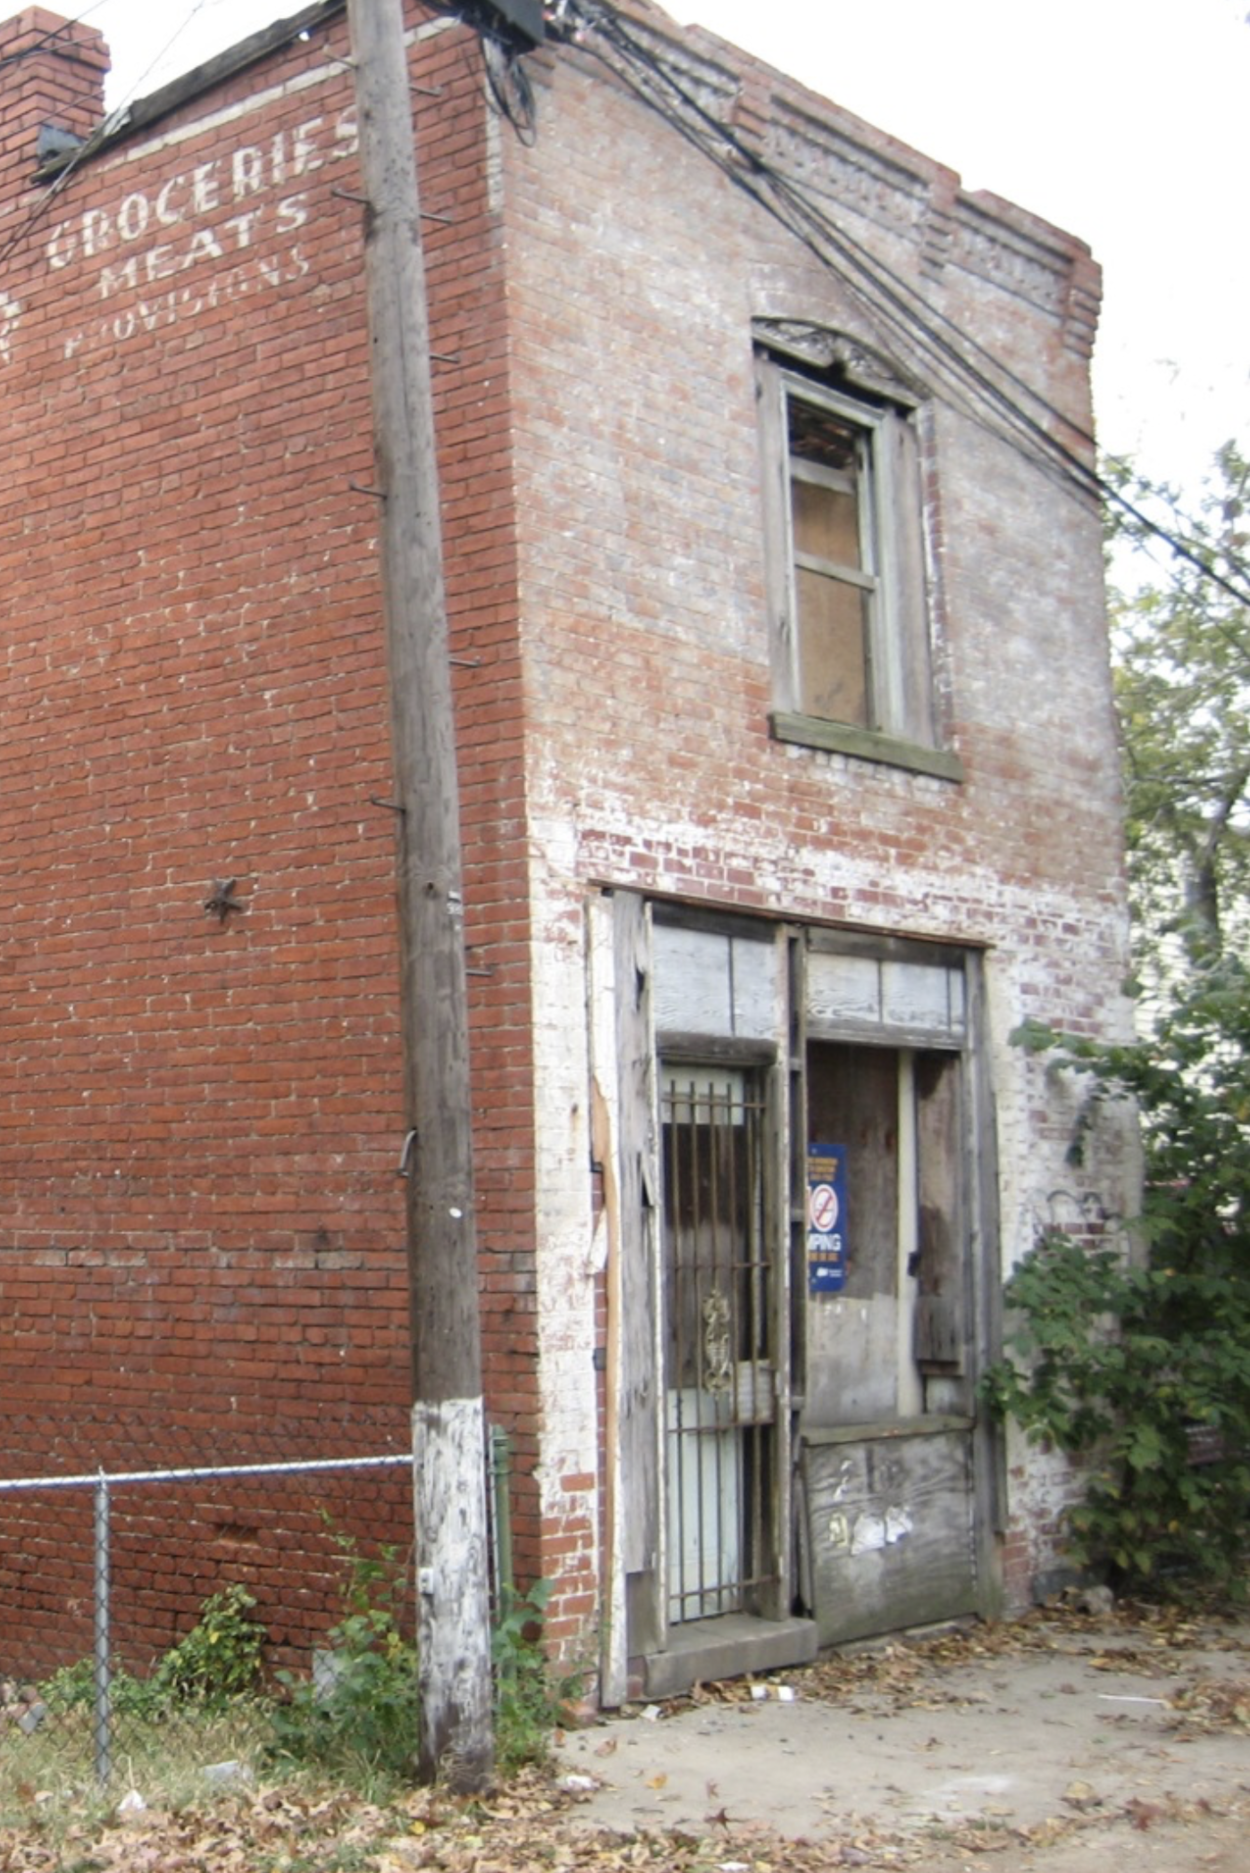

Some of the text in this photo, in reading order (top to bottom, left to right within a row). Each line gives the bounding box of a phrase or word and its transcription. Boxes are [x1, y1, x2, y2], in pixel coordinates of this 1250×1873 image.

[46, 106, 359, 269] GROCERIES
[63, 244, 310, 359] POVISIONS
[97, 193, 308, 299] MEATS
